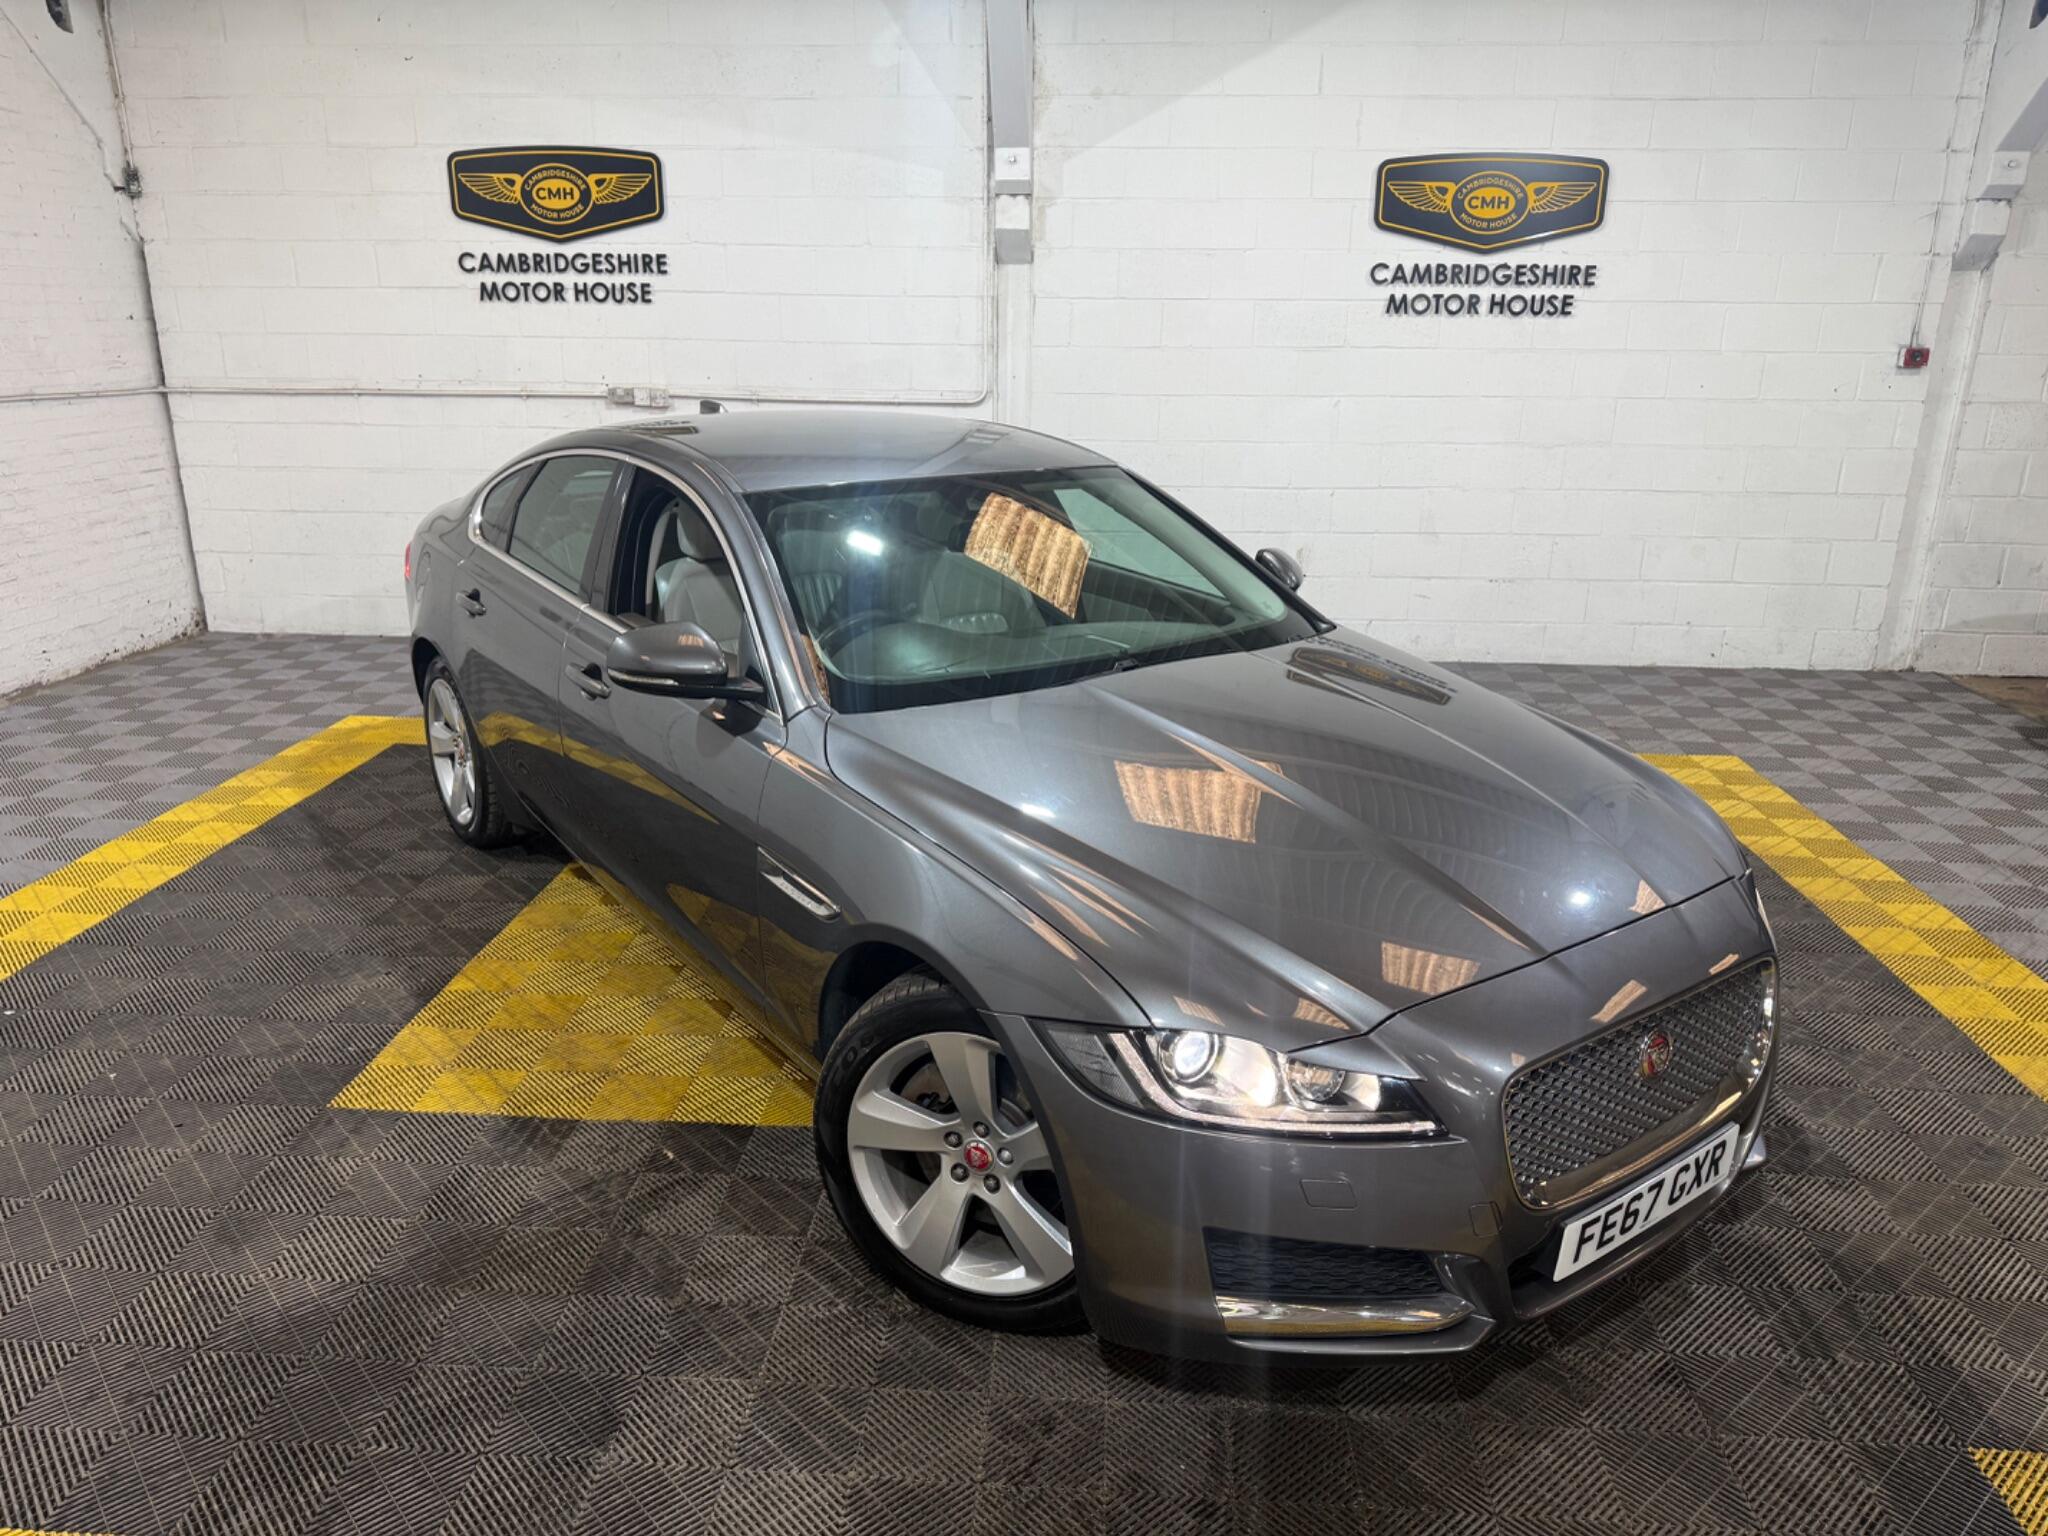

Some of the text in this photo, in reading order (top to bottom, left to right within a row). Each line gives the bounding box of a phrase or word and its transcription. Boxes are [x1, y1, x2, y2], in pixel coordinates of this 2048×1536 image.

[525, 169, 587, 191] CAMBRIDGESHIRE
[1457, 176, 1524, 199] CAMBRIDGESHIRE
[535, 187, 575, 201] CMH
[1467, 196, 1510, 210] CMH
[530, 203, 585, 219] MOTOR HOUSE
[1460, 212, 1518, 229] MOTOR HOUSE
[458, 252, 668, 275] CAMBRIDGESHIRE
[1370, 262, 1598, 287] CAMBRIDGESHIRE
[480, 282, 653, 303] MOTOR HOUSE
[1385, 293, 1575, 316] MOTOR HOUSE
[1572, 1139, 1728, 1264] FE67 GXR
